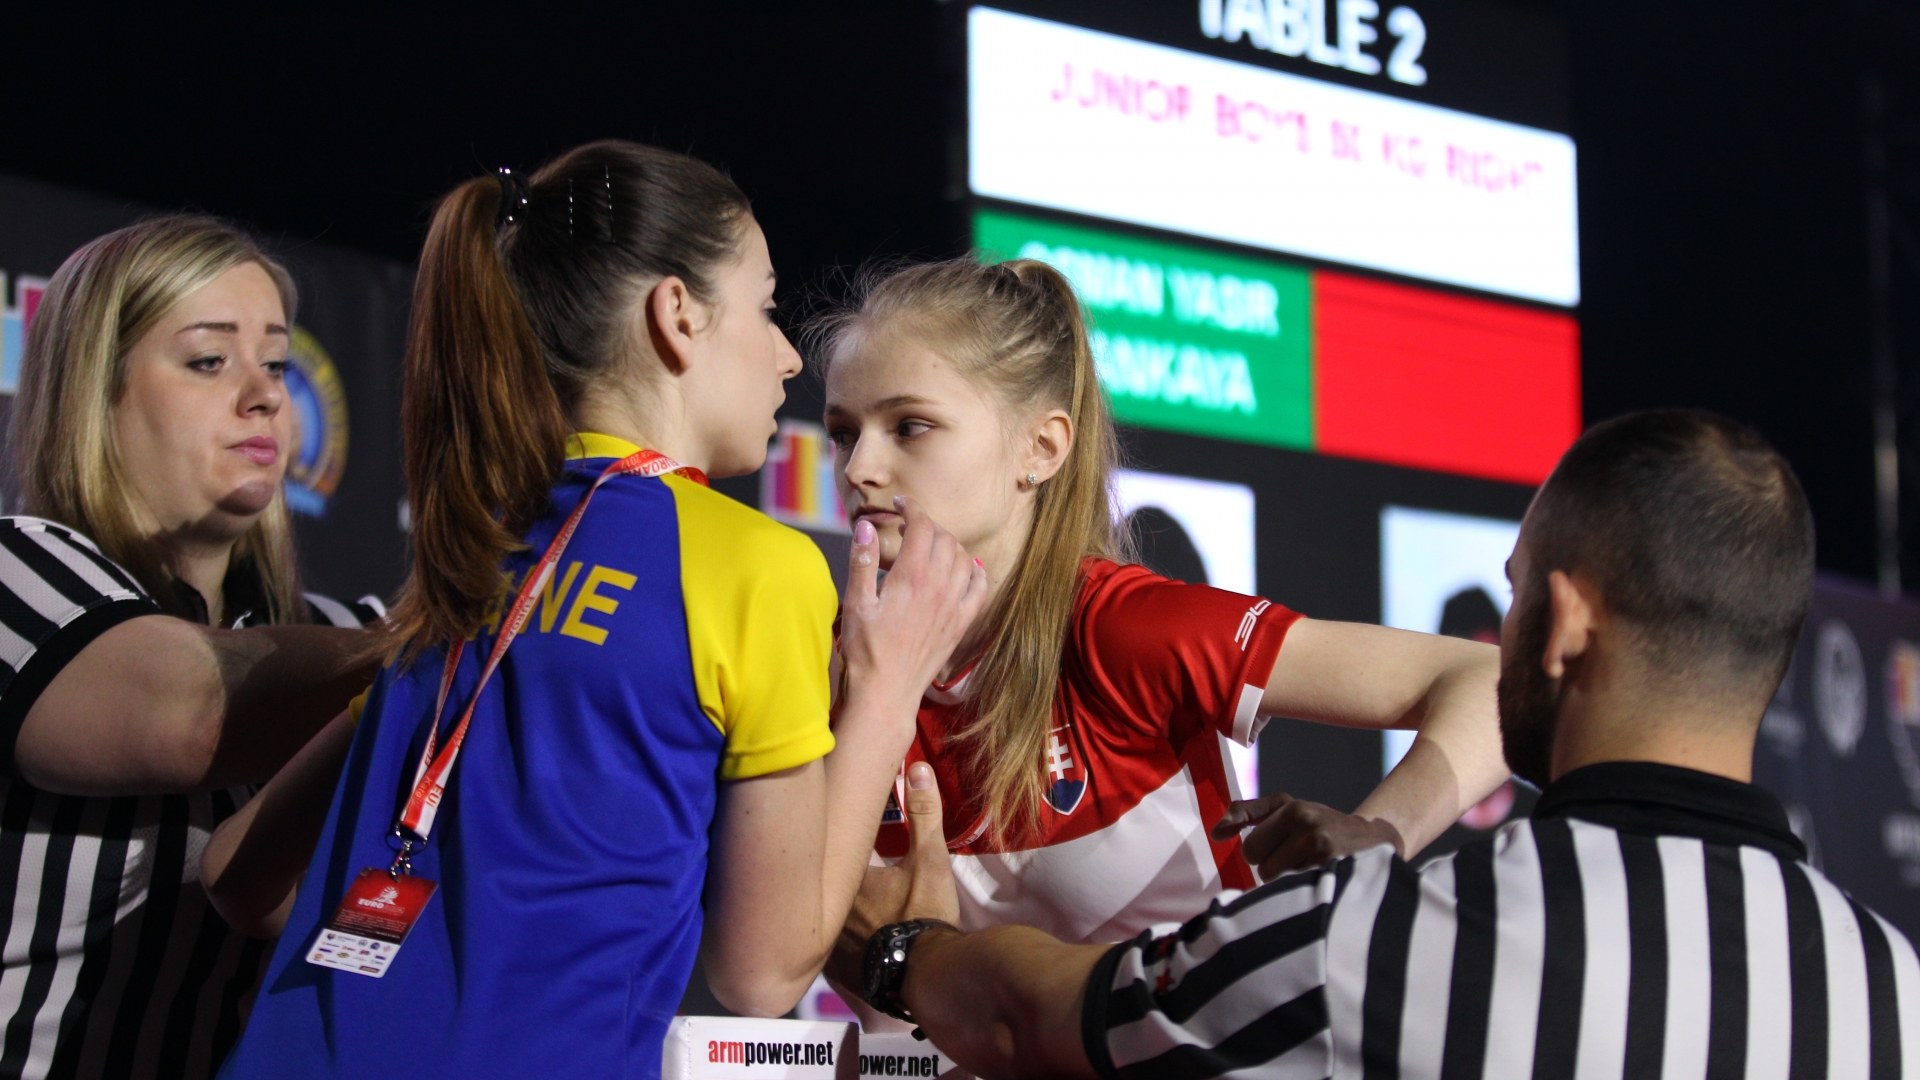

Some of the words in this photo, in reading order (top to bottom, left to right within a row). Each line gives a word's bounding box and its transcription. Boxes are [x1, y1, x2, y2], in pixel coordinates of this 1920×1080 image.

[1386, 5, 1428, 86] 2
[357, 897, 385, 909] EURO
[707, 1039, 834, 1067] armpower.net
